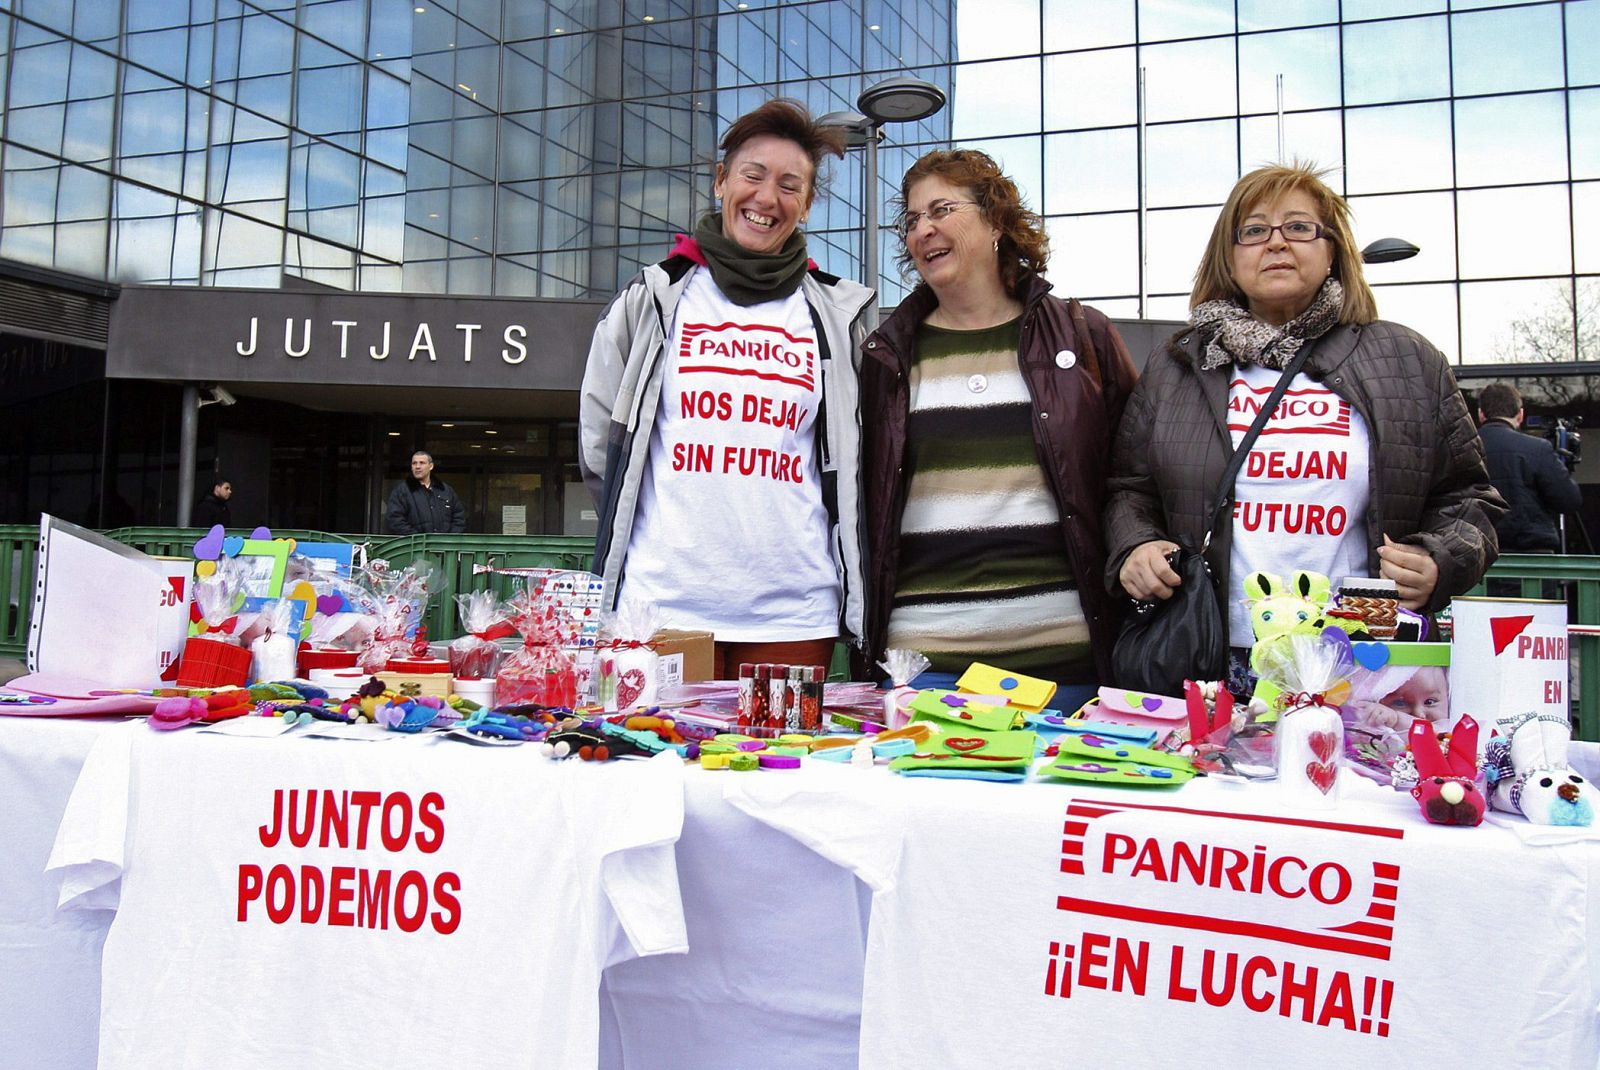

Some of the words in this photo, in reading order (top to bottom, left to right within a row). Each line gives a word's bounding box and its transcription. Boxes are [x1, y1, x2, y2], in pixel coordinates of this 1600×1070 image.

[236, 317, 527, 364] JUTJATS
[681, 391, 733, 421] NOS
[672, 443, 715, 473] SIN
[1247, 451, 1348, 480] DEJAN
[1518, 635, 1566, 660] PANRI
[1543, 680, 1562, 704] EN
[258, 789, 445, 855] JUNTOS
[236, 864, 462, 935] PODEMOS
[1044, 930, 1150, 998] ¡¡EN
[1167, 945, 1395, 1038] LUCHA!!
